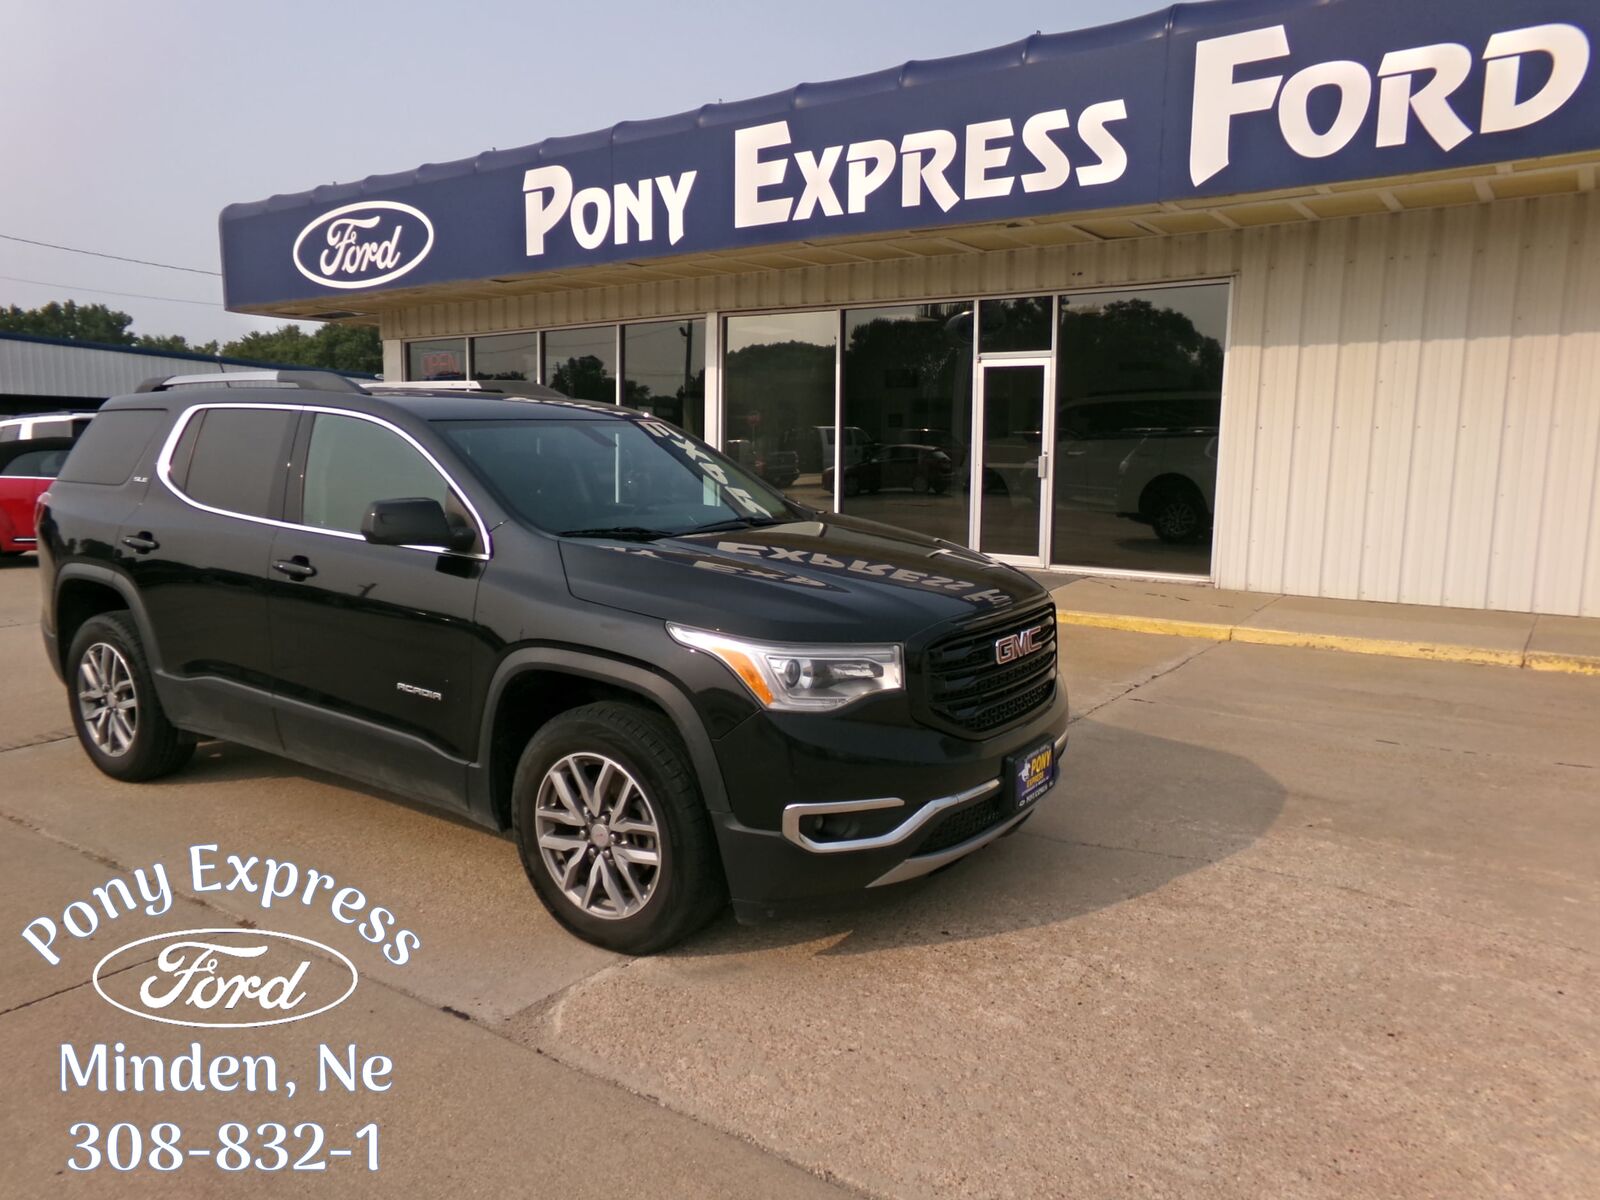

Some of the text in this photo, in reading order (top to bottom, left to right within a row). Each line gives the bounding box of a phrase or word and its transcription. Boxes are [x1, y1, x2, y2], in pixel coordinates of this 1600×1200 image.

[320, 216, 403, 276] Ford
[995, 626, 1042, 664] GMC
[1031, 750, 1051, 776] PONY
